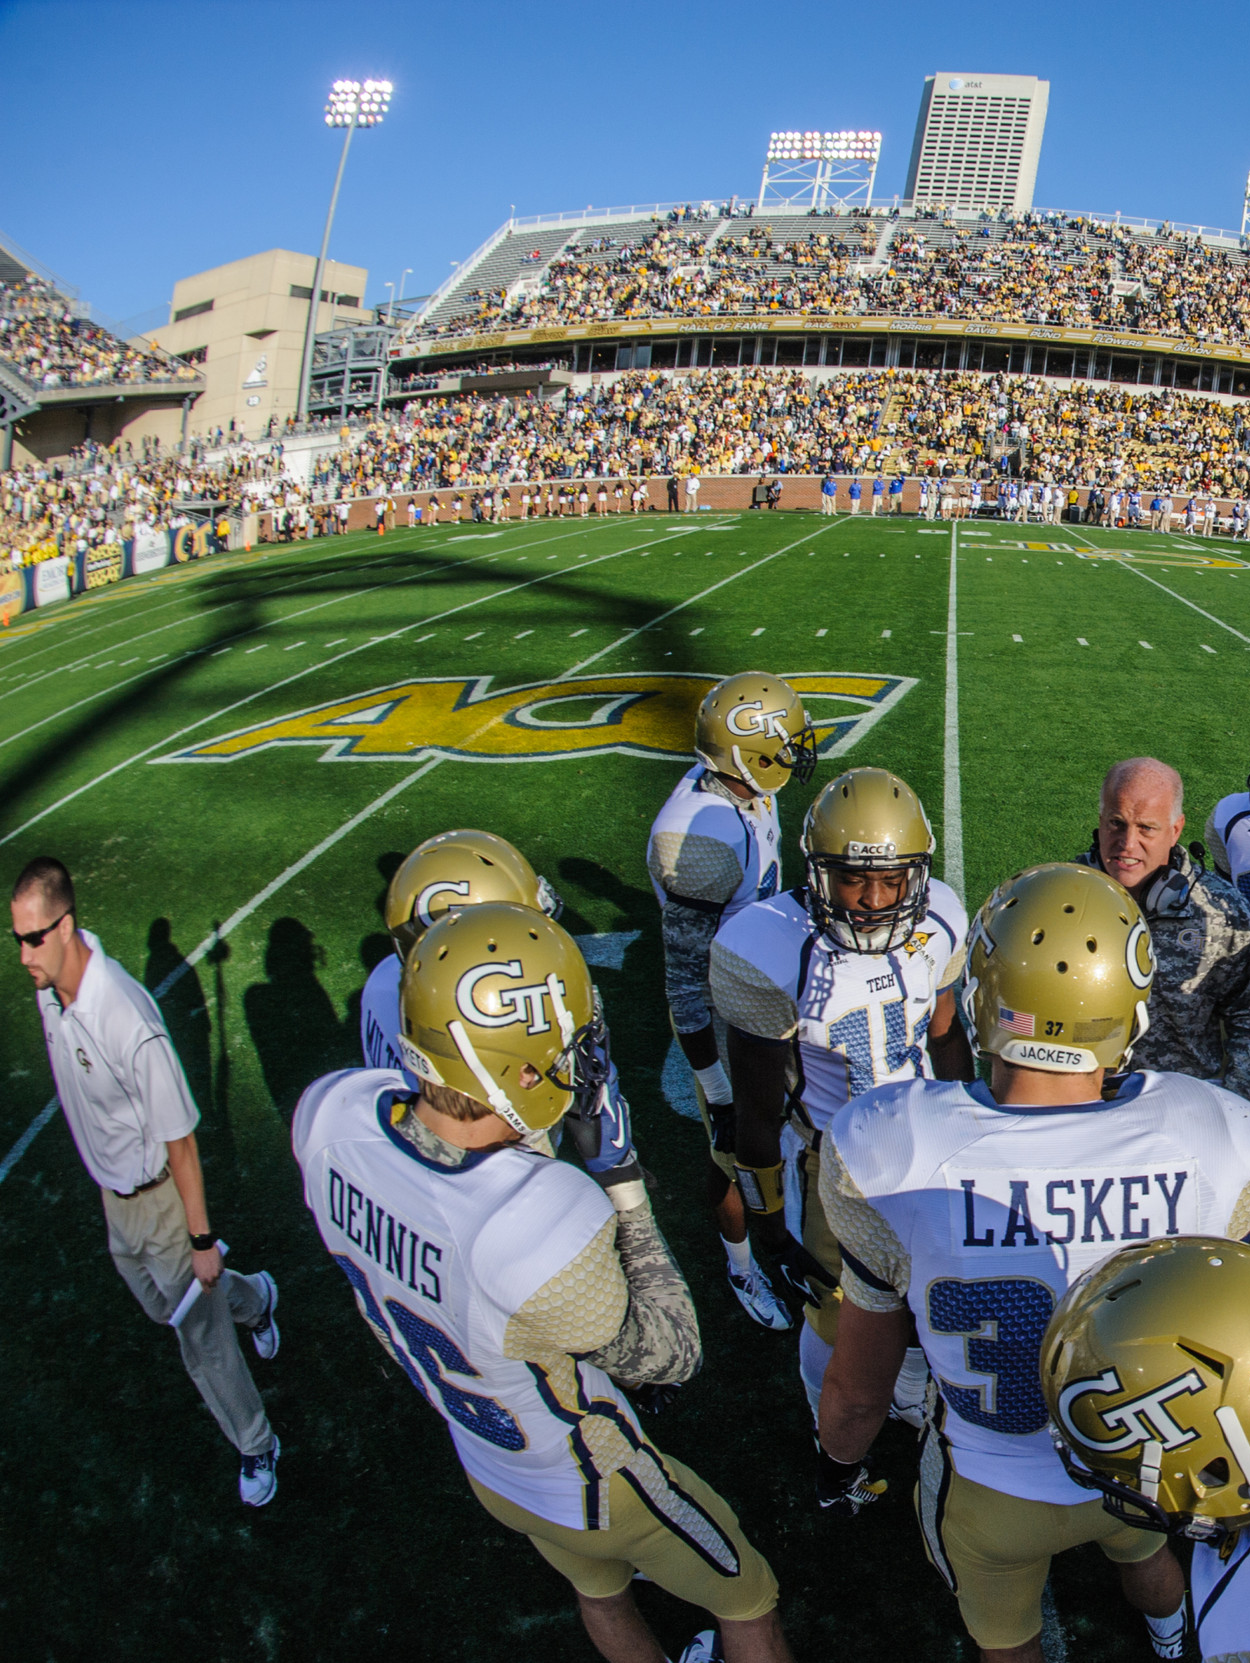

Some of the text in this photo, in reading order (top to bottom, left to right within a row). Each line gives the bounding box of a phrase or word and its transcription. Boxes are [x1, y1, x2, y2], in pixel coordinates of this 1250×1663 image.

[679, 322, 770, 331] HALL OF FAME
[964, 327, 998, 335] DAVIS
[1093, 337, 1144, 347] FLOWERS
[1174, 345, 1212, 355] GUYON
[725, 700, 787, 739] GT
[861, 844, 883, 855] ACC
[417, 880, 470, 927] G
[866, 973, 896, 993] TECH
[455, 959, 566, 1037] GT
[1045, 1021, 1064, 1037] 37
[1019, 1045, 1083, 1066] JACKETS
[960, 1170, 1188, 1248] LASKEY
[329, 1167, 443, 1305] DENNIS
[925, 1274, 1057, 1437] 3
[1058, 1365, 1208, 1454] GT
